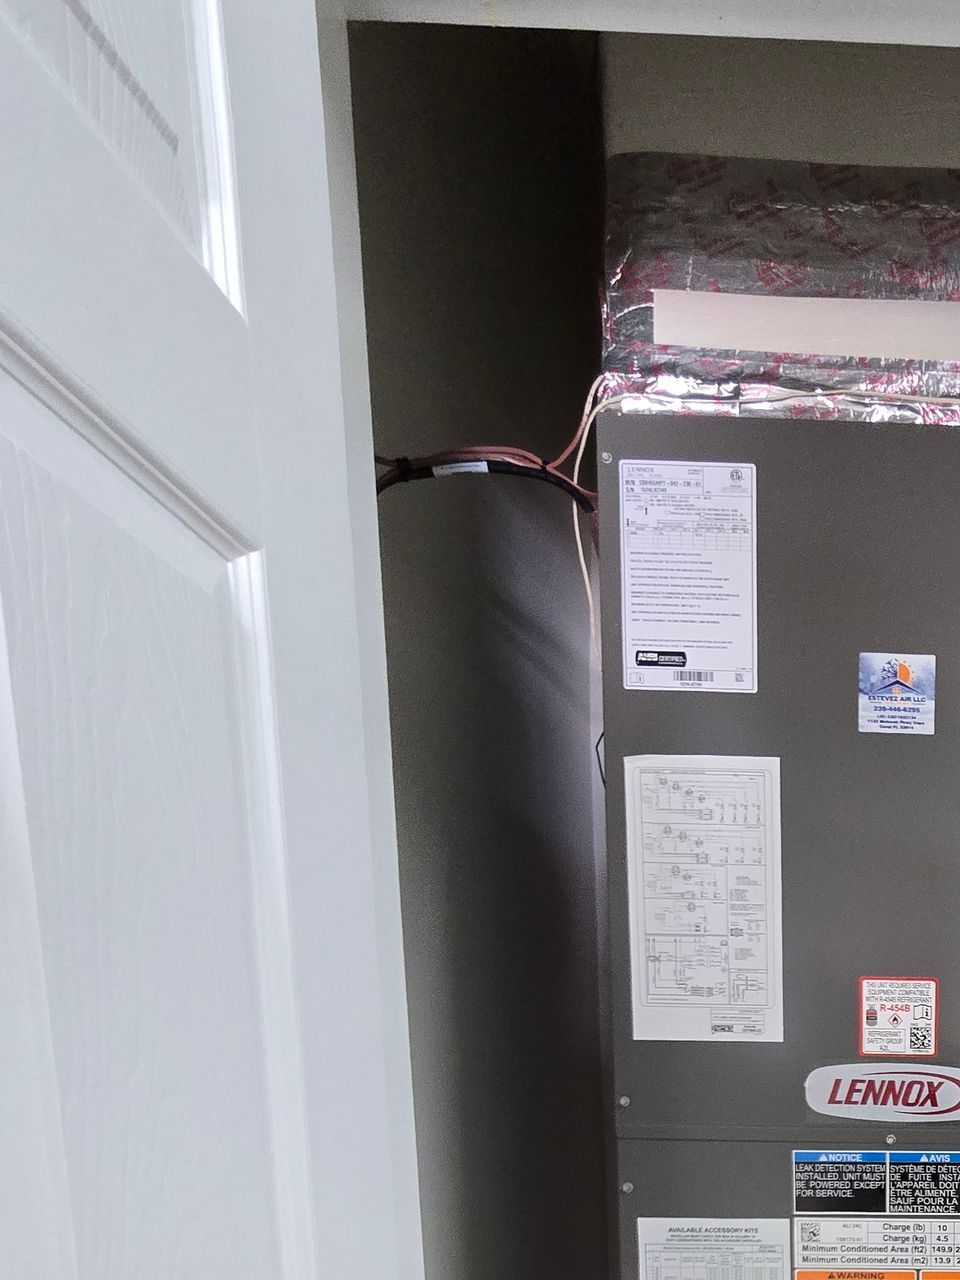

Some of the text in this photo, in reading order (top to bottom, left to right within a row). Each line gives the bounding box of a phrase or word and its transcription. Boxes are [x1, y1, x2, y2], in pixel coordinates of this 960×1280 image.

[880, 1004, 910, 1012] R-454B
[827, 1079, 945, 1107] LENNOX
[796, 1164, 886, 1172] LEAK DETECTION SYSTEM
[890, 1164, 925, 1173] SYSTÈME
[810, 1181, 851, 1189] POWERED
[890, 1205, 958, 1213] MAINTENANCE.
[883, 1223, 911, 1232] Charge
[913, 1223, 926, 1232] (lb)
[883, 1235, 911, 1244] Charge
[912, 1235, 927, 1244] (kg)
[841, 1244, 888, 1252] Conditioned
[911, 1257, 929, 1265] (m2)
